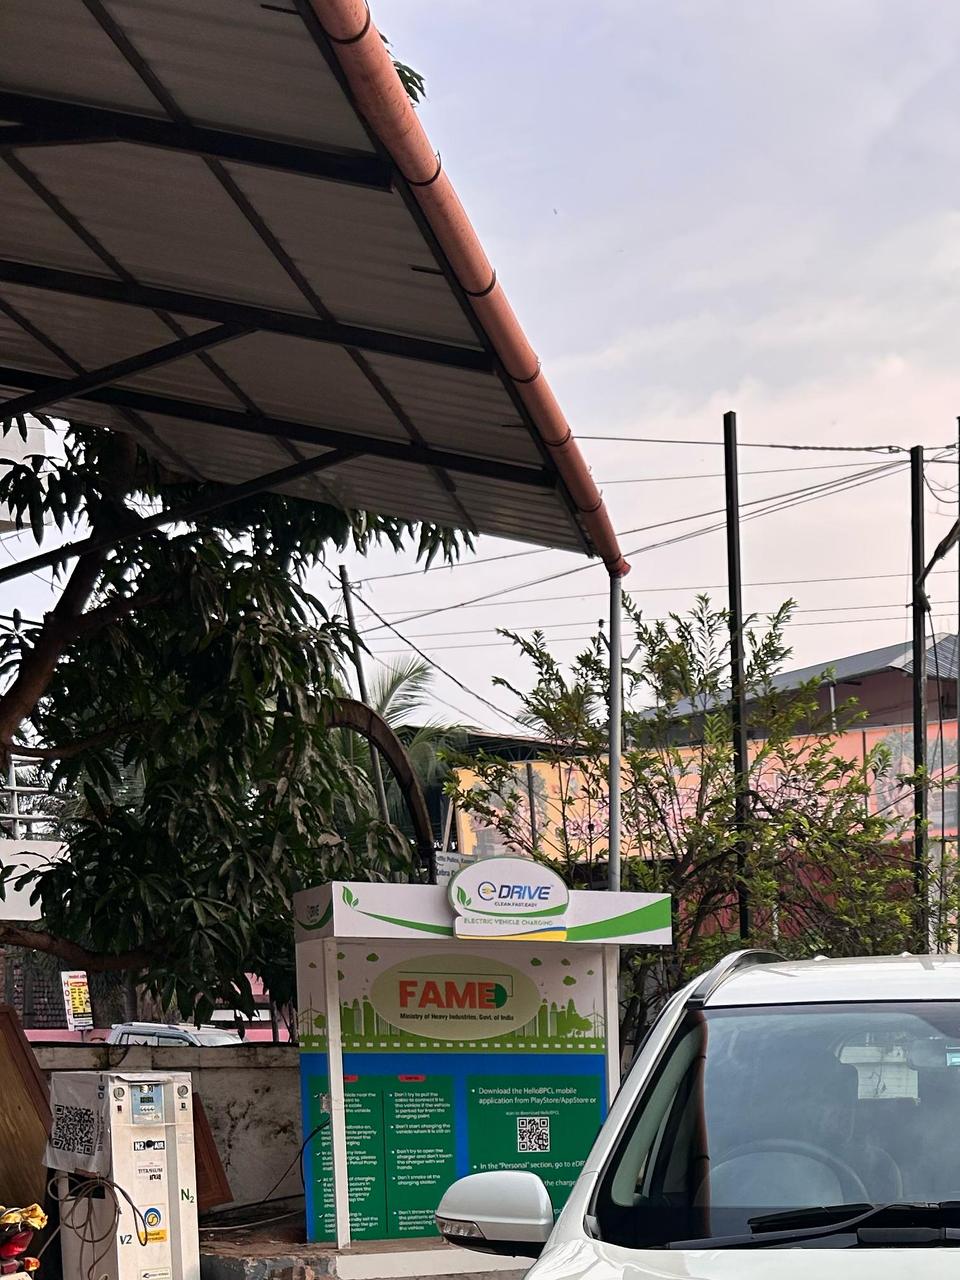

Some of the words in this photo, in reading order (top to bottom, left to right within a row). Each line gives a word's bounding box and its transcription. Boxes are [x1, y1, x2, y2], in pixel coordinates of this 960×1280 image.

[399, 980, 497, 1009] FAME
[530, 1096, 589, 1104] PlayStore/AppStore
[530, 1161, 553, 1169] section,
[120, 1234, 132, 1245] V2
